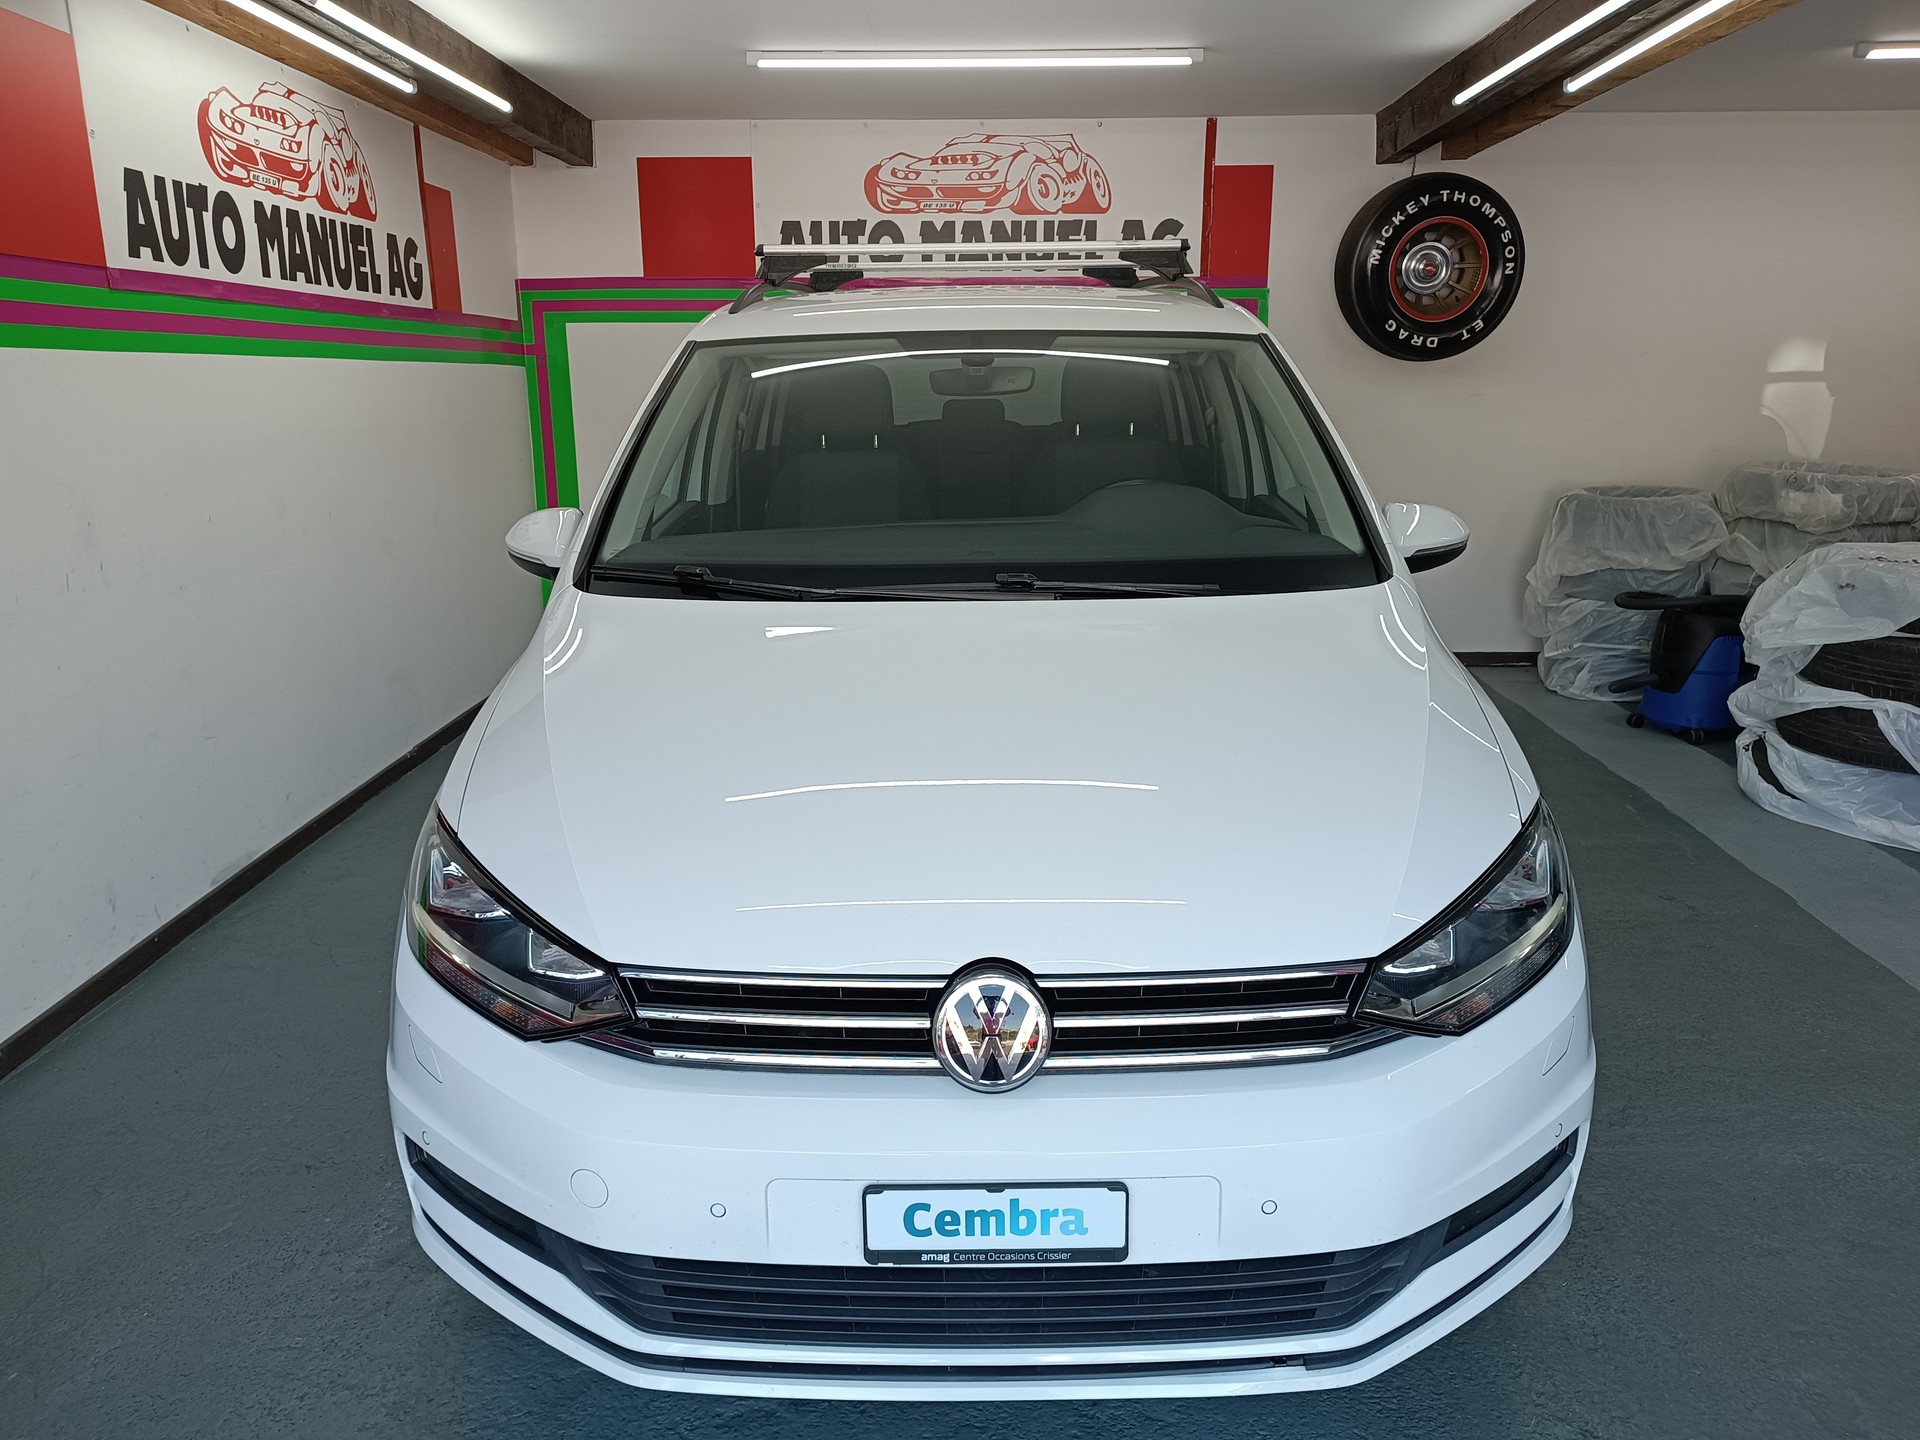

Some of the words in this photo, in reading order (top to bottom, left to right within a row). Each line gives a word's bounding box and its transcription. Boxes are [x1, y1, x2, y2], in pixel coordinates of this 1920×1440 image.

[123, 167, 246, 275] AUTO
[254, 200, 381, 294] MANUEL
[386, 233, 423, 301] AG
[919, 219, 1104, 271] MANUEL
[1368, 194, 1430, 265] MICKEY
[1439, 190, 1516, 275] THOMPSON
[1385, 319, 1439, 348] DRAG
[903, 1198, 1088, 1237] Cembra
[921, 1252, 950, 1263] amag
[953, 1252, 986, 1261] Centre
[987, 1252, 1035, 1261] Occasions
[1037, 1251, 1072, 1260] Crissier
